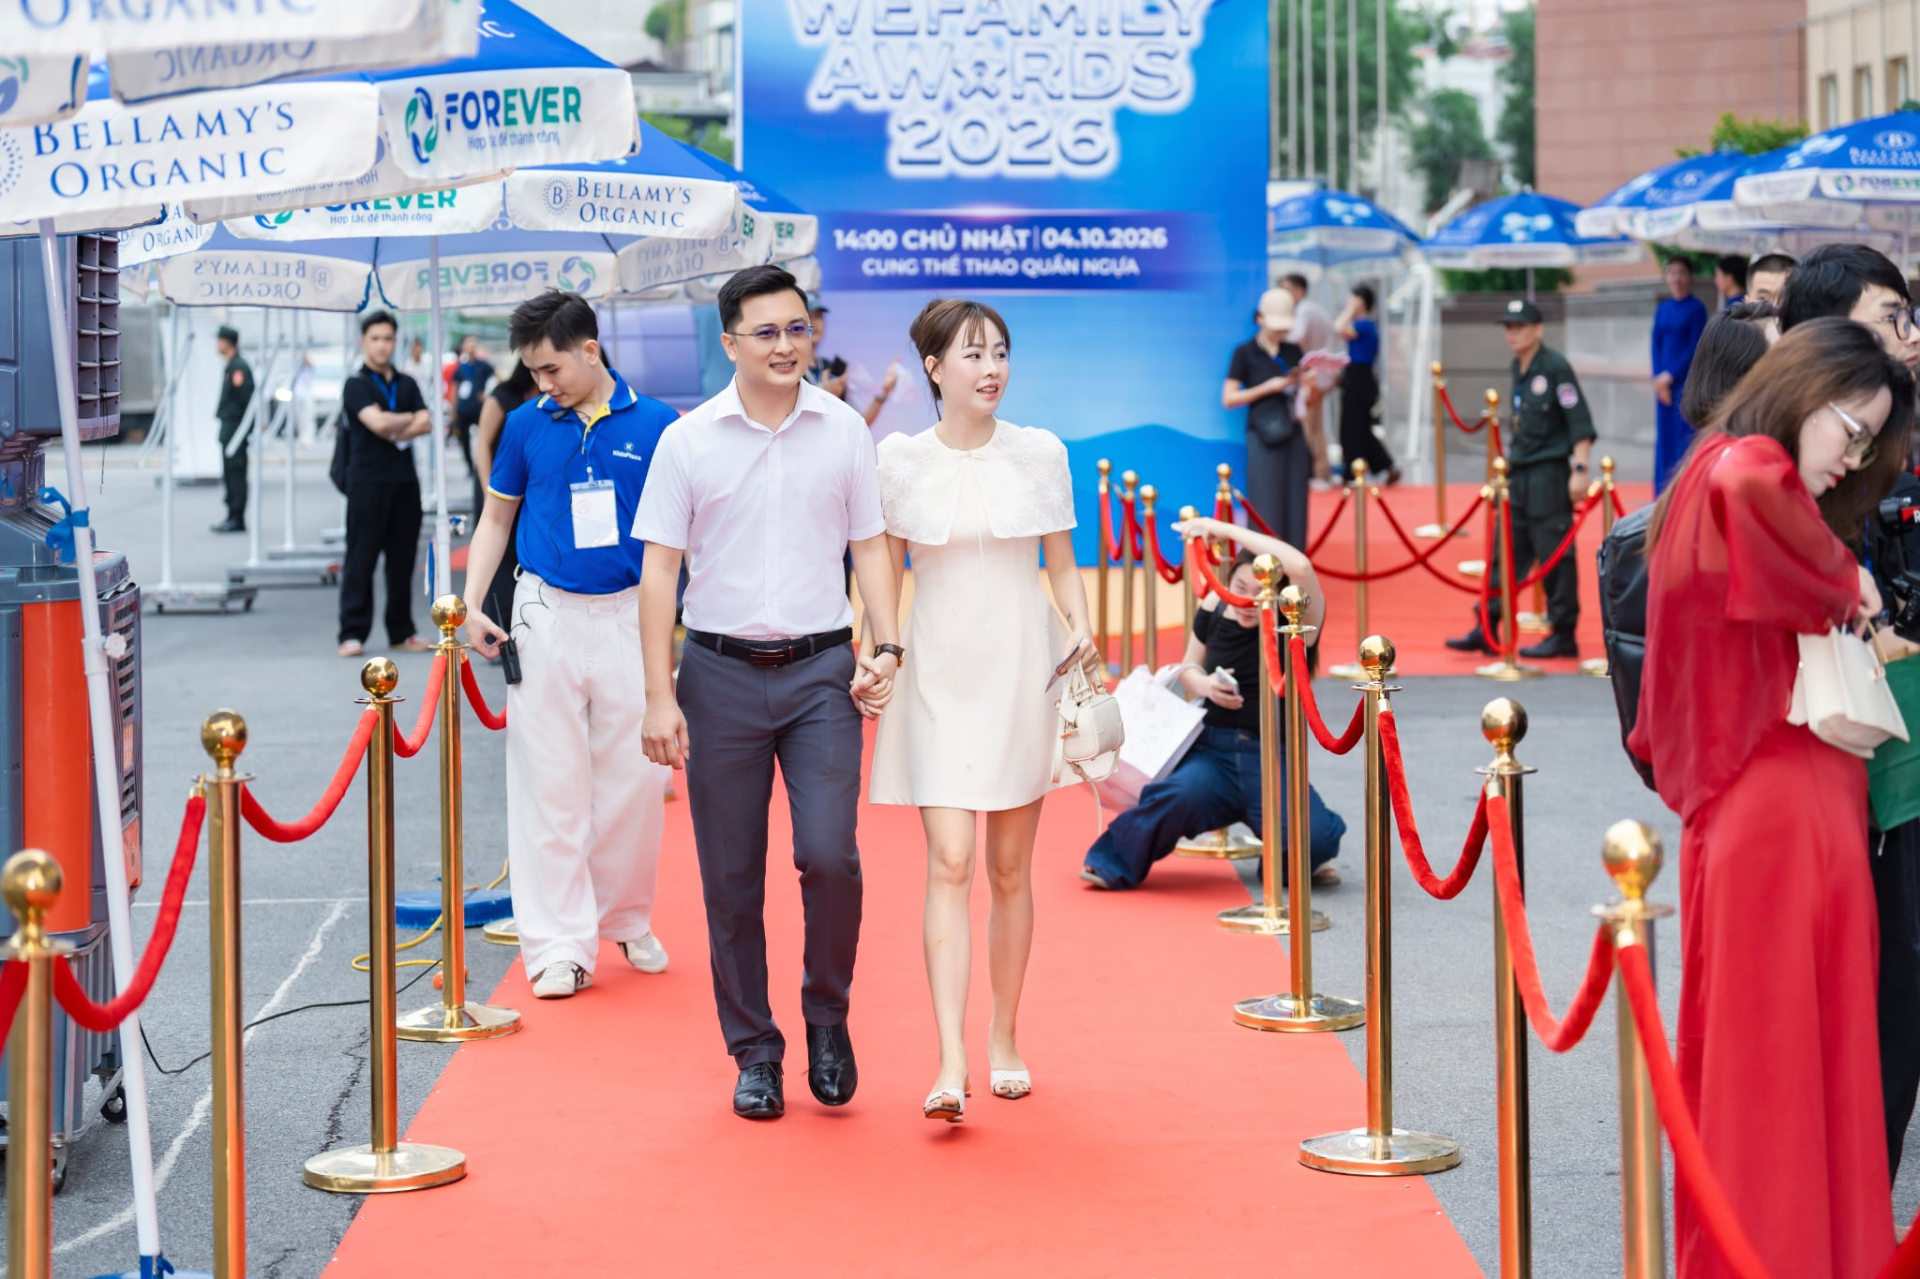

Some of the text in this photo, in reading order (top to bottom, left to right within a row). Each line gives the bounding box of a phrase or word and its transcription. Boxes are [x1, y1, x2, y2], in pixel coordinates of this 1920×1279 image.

[445, 86, 582, 132] FOREVER
[33, 101, 295, 157] BELLAMY'S
[896, 114, 1112, 168] 2026
[50, 147, 286, 198] ORGANIC
[577, 177, 691, 205] BELLAMY'S
[579, 202, 685, 228] ORGANIC
[143, 224, 203, 252] ORGANI
[834, 222, 1168, 255] 14:00 CHỦ NHẬT 04.10.2026
[862, 258, 917, 276] CUNG
[965, 258, 1019, 276] THAO
